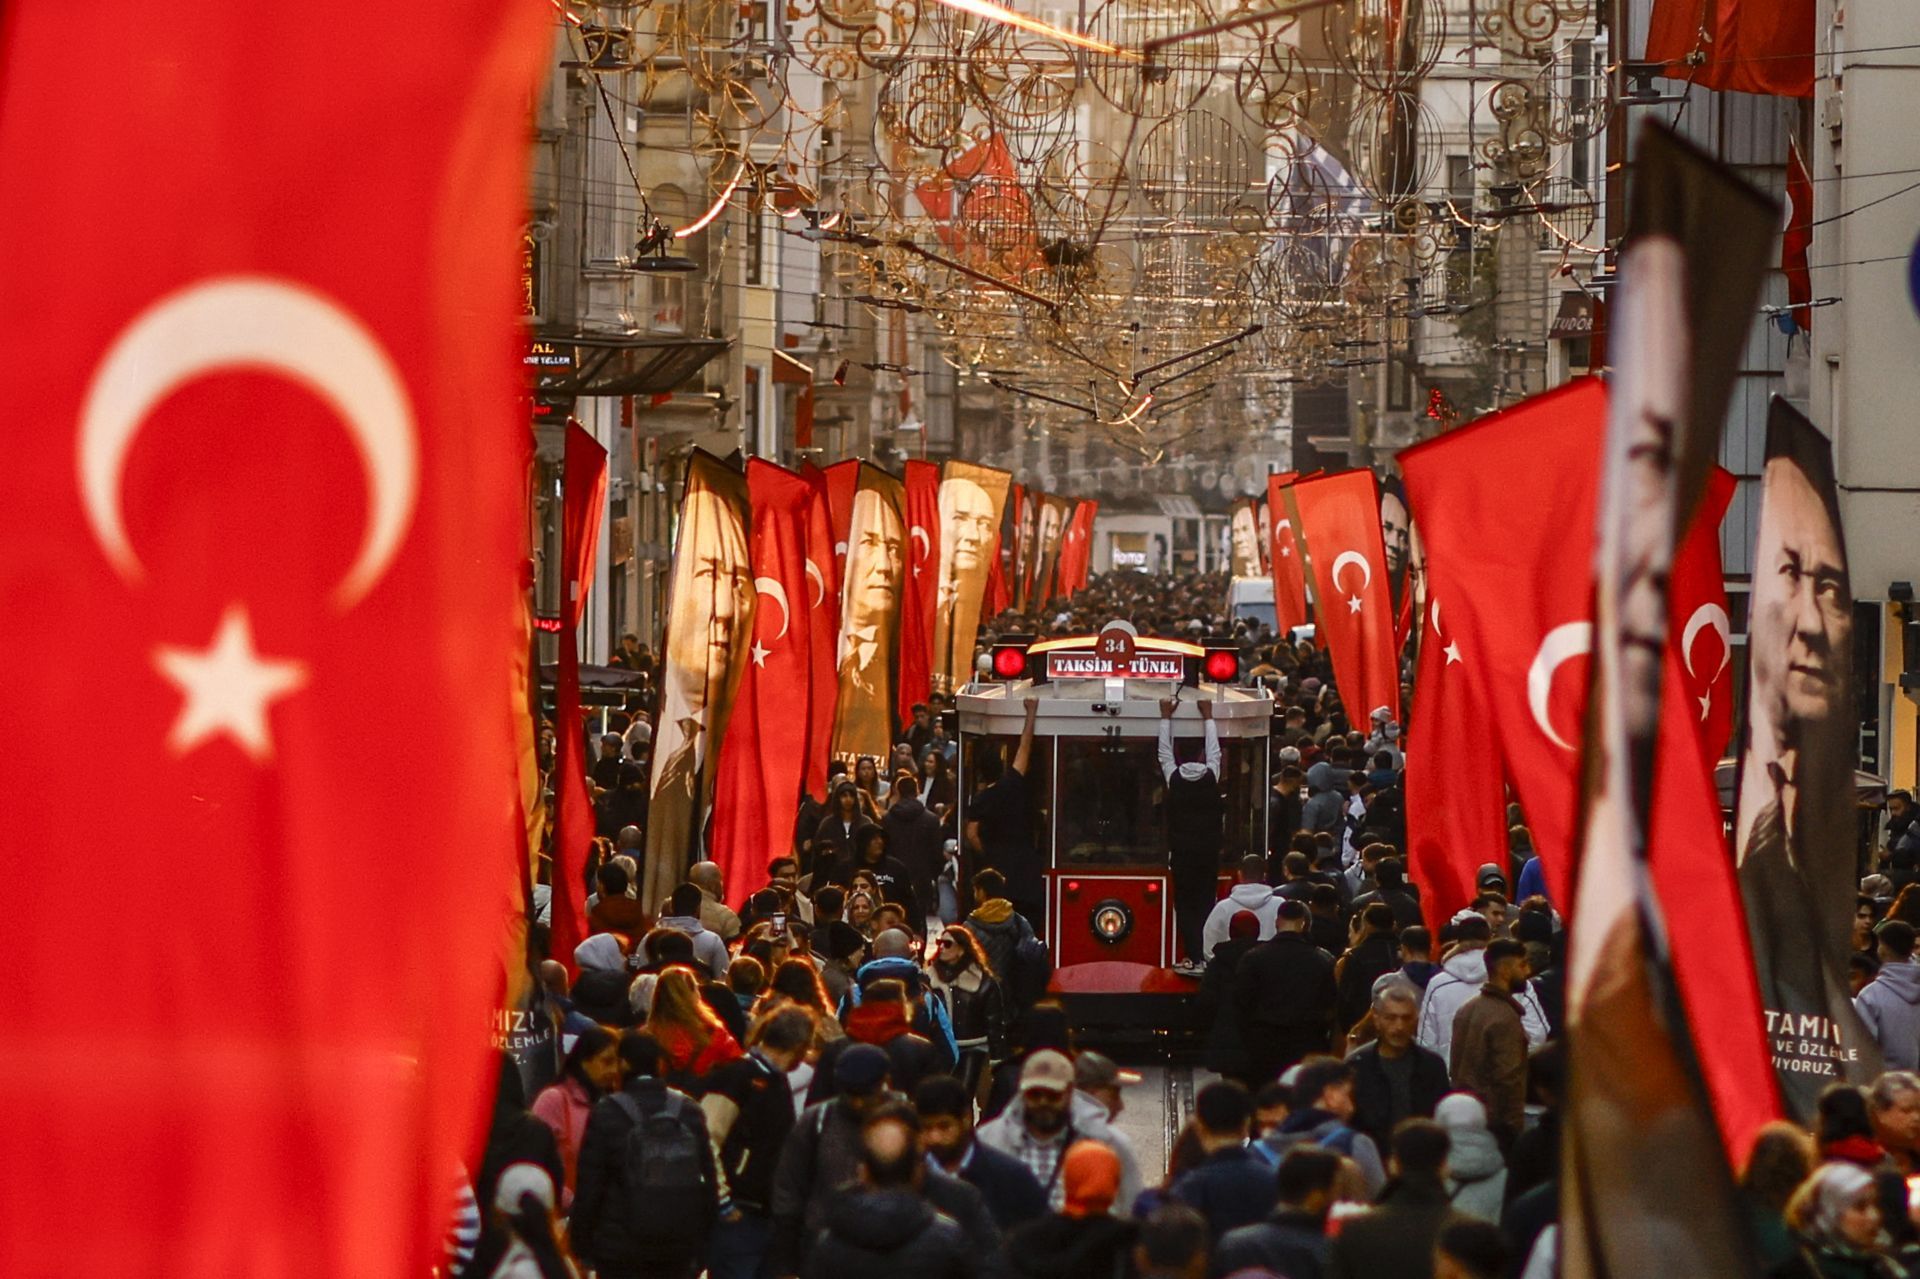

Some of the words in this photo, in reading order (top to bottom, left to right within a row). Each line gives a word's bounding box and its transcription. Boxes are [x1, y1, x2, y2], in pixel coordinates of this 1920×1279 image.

[1553, 317, 1593, 330] TUDOR
[530, 343, 555, 353] AL
[1105, 639, 1126, 653] 34
[1054, 656, 1113, 673] TAKSİM
[1129, 656, 1179, 674] TÜNEL
[1776, 1039, 1794, 1053] VE
